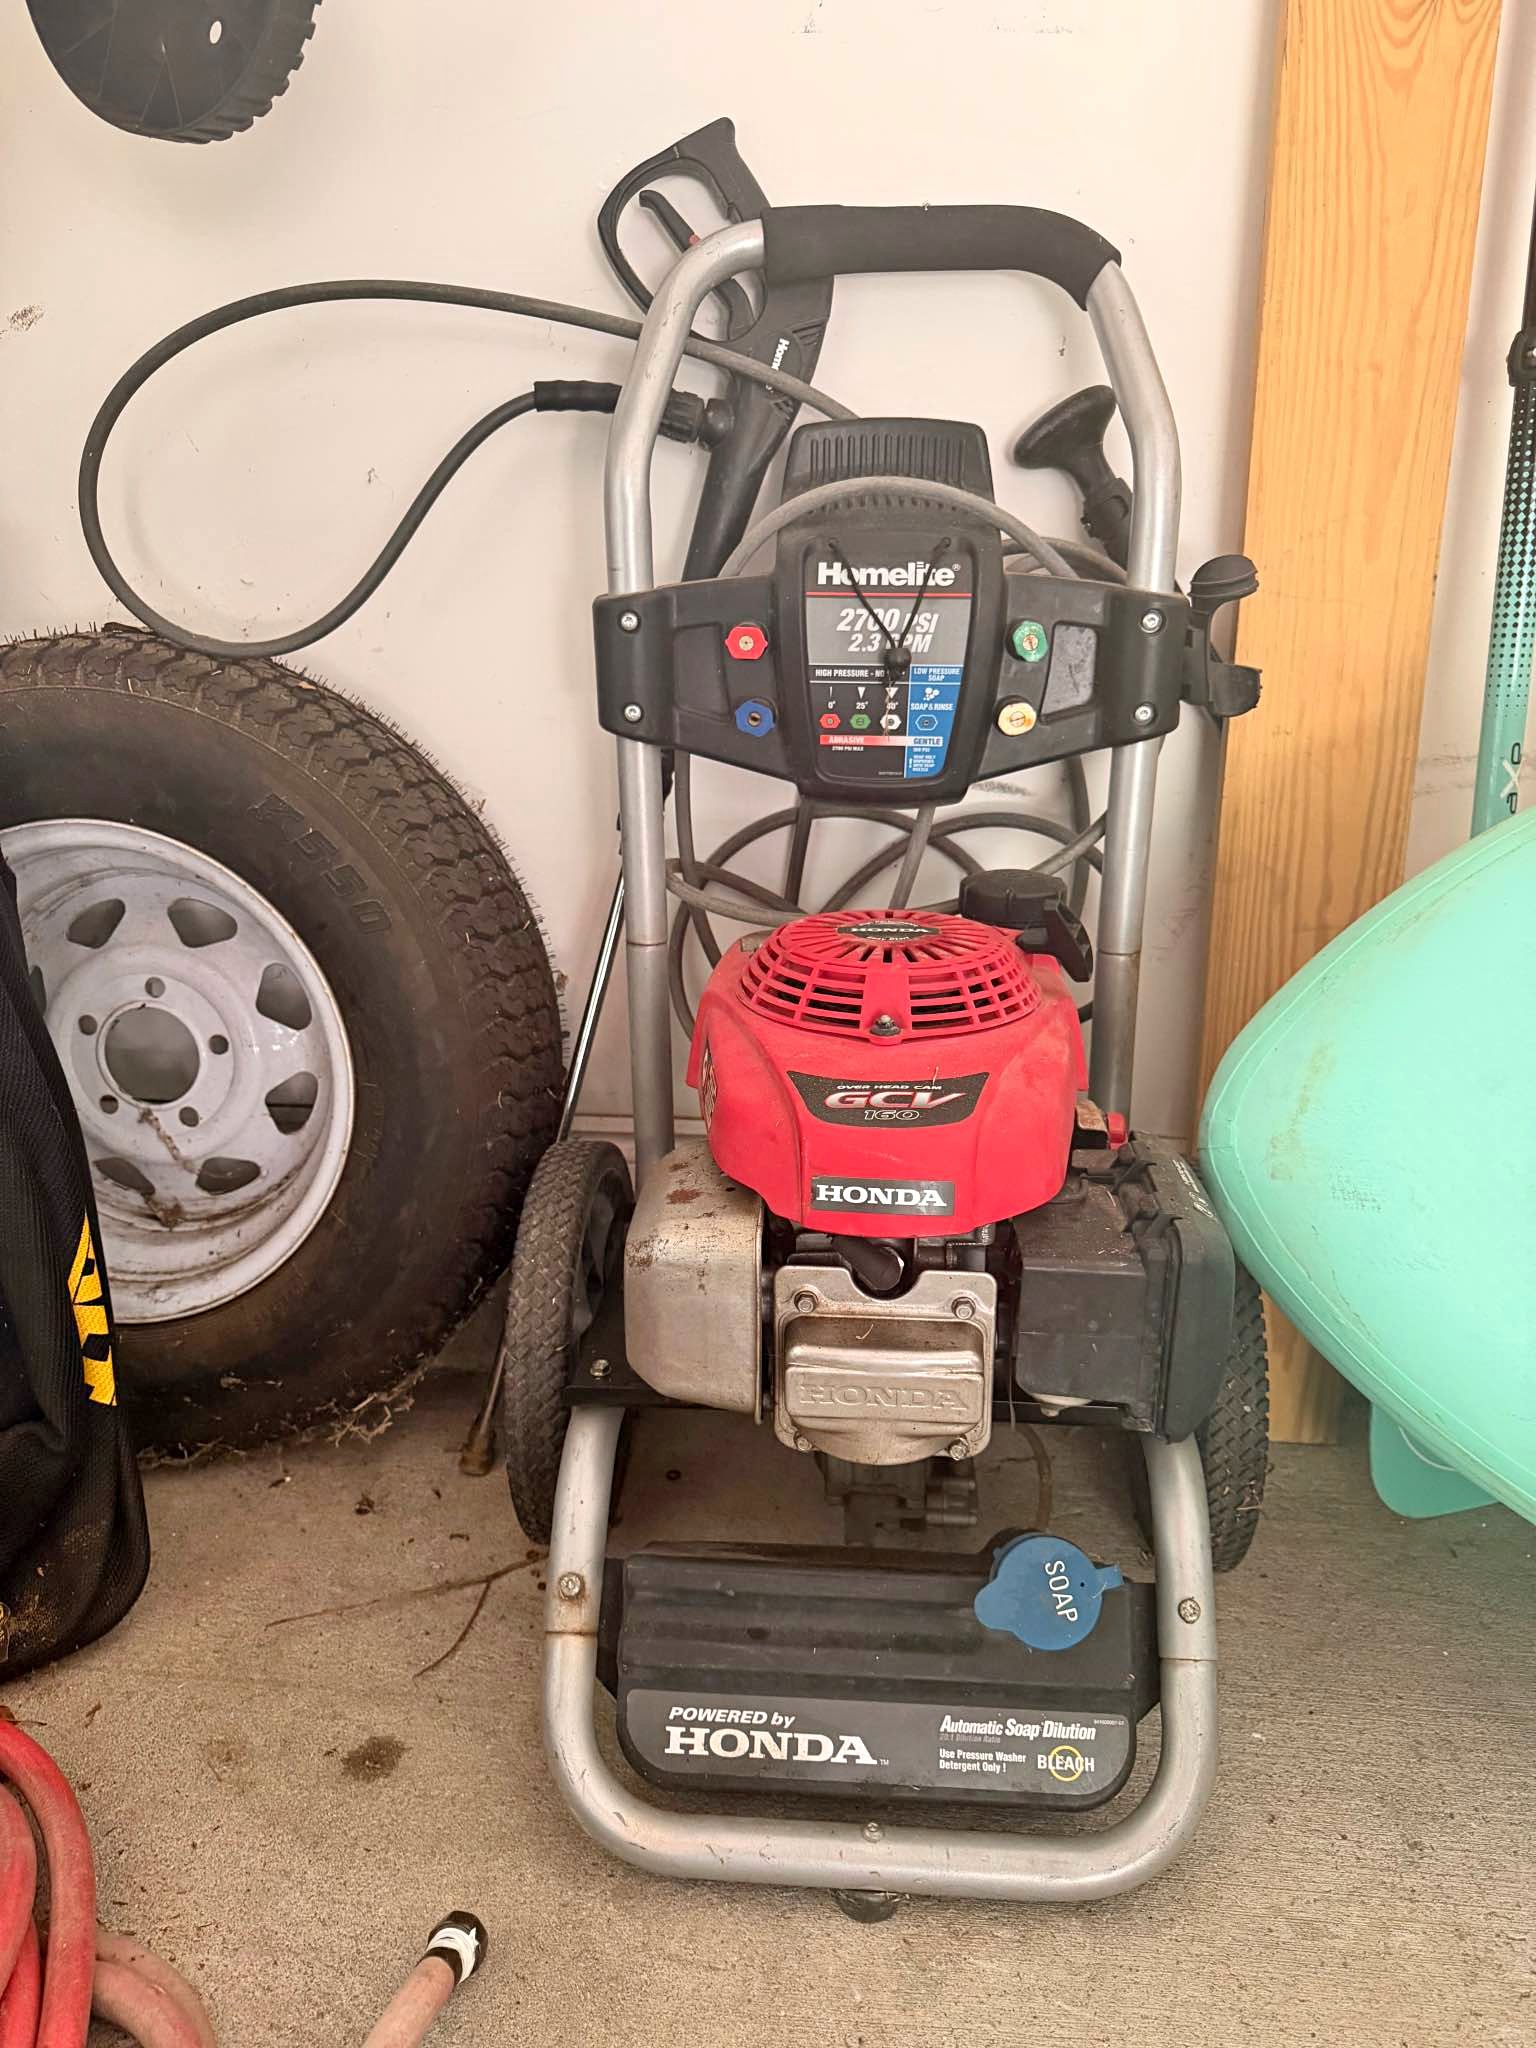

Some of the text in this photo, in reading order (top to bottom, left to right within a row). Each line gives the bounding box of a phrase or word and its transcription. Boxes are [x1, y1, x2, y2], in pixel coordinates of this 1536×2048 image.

[836, 608, 900, 631] 2700
[848, 633, 882, 652] 2.3
[815, 669, 832, 677] HIGH
[834, 669, 869, 678] PRESSURE
[911, 703, 928, 711] SOAP
[933, 703, 953, 711] RINSE
[825, 1091, 966, 1109] GCV
[864, 1109, 920, 1121] 160
[816, 1184, 947, 1207] HONDA
[799, 1384, 968, 1410] HONDA
[1045, 1560, 1078, 1621] SOAP
[669, 1706, 795, 1728] POWERED by
[940, 1715, 1096, 1741] Automatic Soap Dilution
[664, 1726, 878, 1766] HONDA
[940, 1748, 1026, 1763] Use Pressure Washer
[939, 1760, 981, 1772] Detergent
[982, 1763, 1001, 1774] Only
[1037, 1755, 1095, 1772] BLEACH
